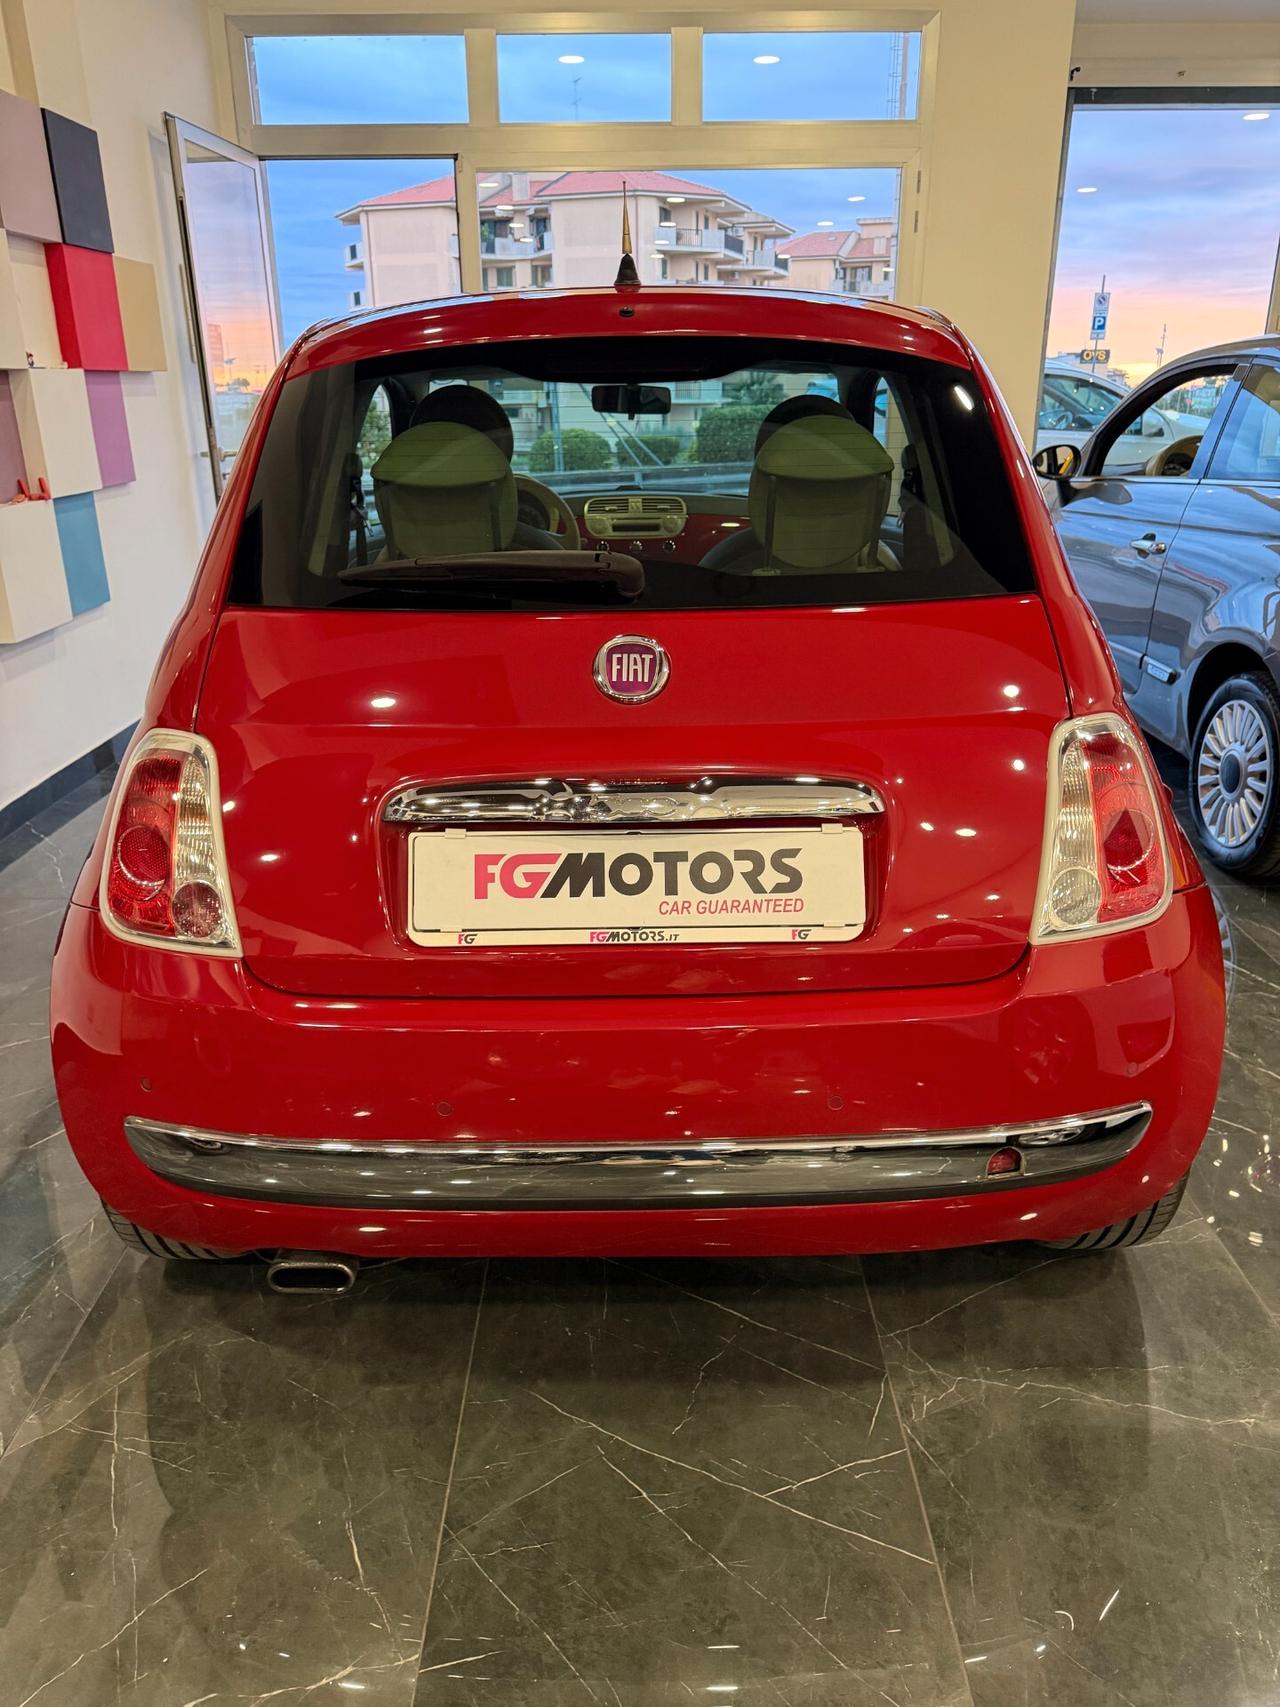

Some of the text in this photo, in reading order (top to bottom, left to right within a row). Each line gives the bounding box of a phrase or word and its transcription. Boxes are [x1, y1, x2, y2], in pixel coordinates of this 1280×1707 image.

[1094, 317, 1104, 329] P
[611, 653, 653, 682] FIAT
[474, 848, 803, 899] FGMOTORS
[659, 898, 804, 916] CAR GUARANTEED
[458, 933, 478, 944] FG
[590, 931, 679, 942] FGMOTORS.IT
[791, 929, 812, 940] FG
